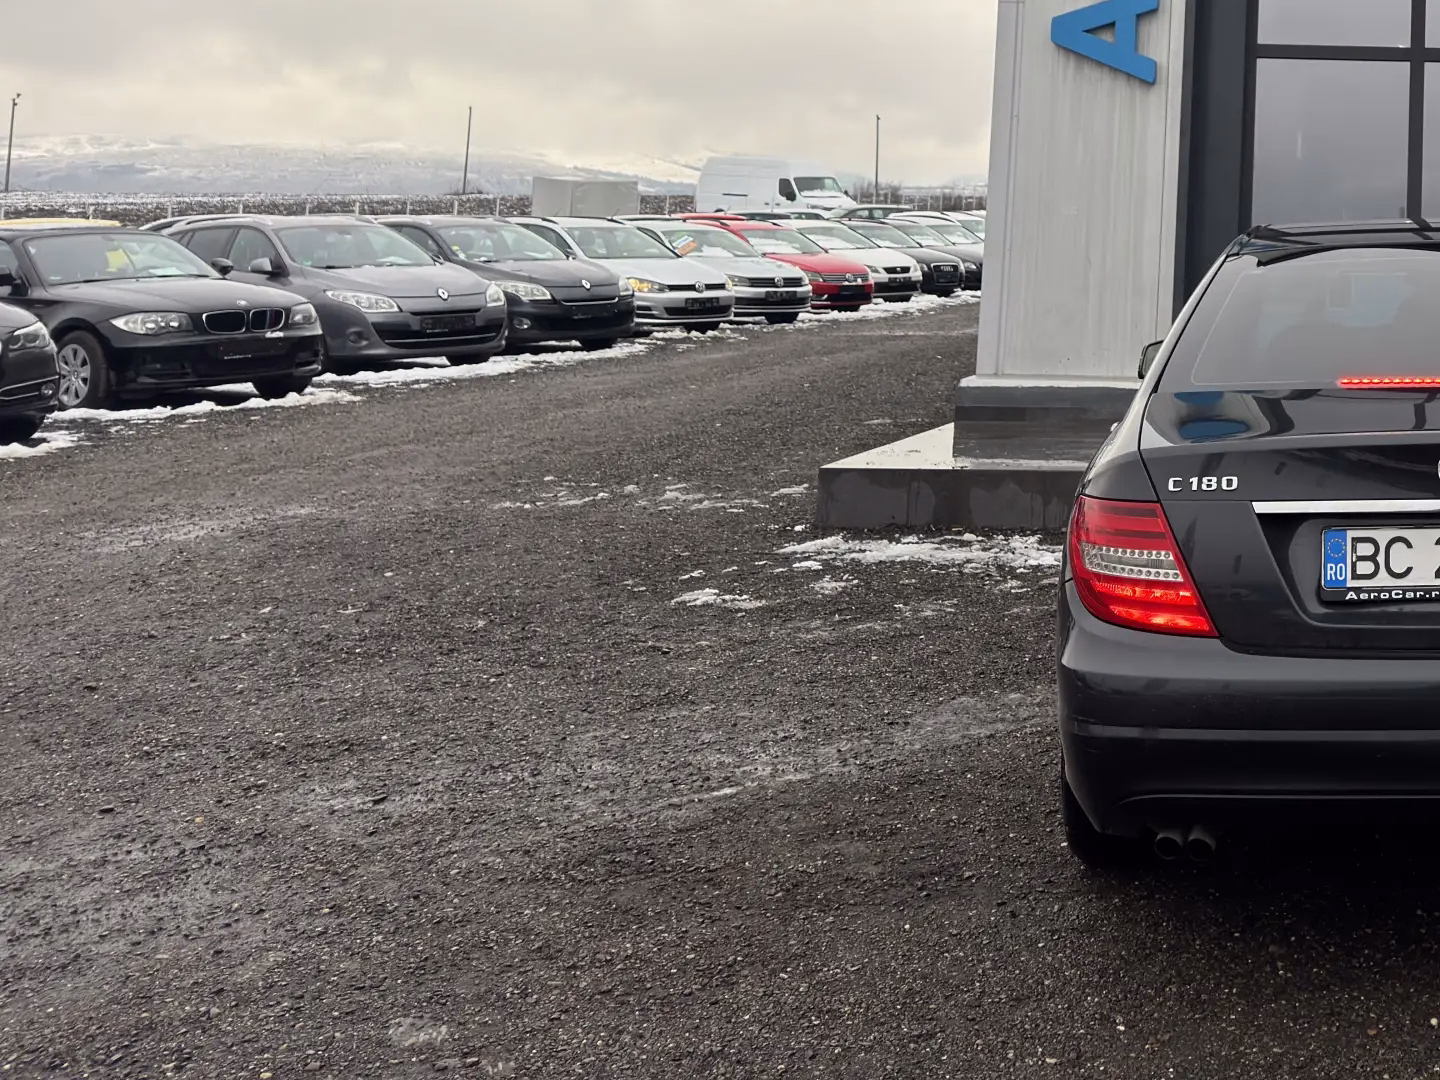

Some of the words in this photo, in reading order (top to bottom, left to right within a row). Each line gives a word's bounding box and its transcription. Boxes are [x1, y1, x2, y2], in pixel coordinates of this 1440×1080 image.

[1167, 477, 1183, 491] C
[1189, 476, 1238, 491] 180
[1351, 536, 1414, 581] BC
[1327, 563, 1346, 581] RO
